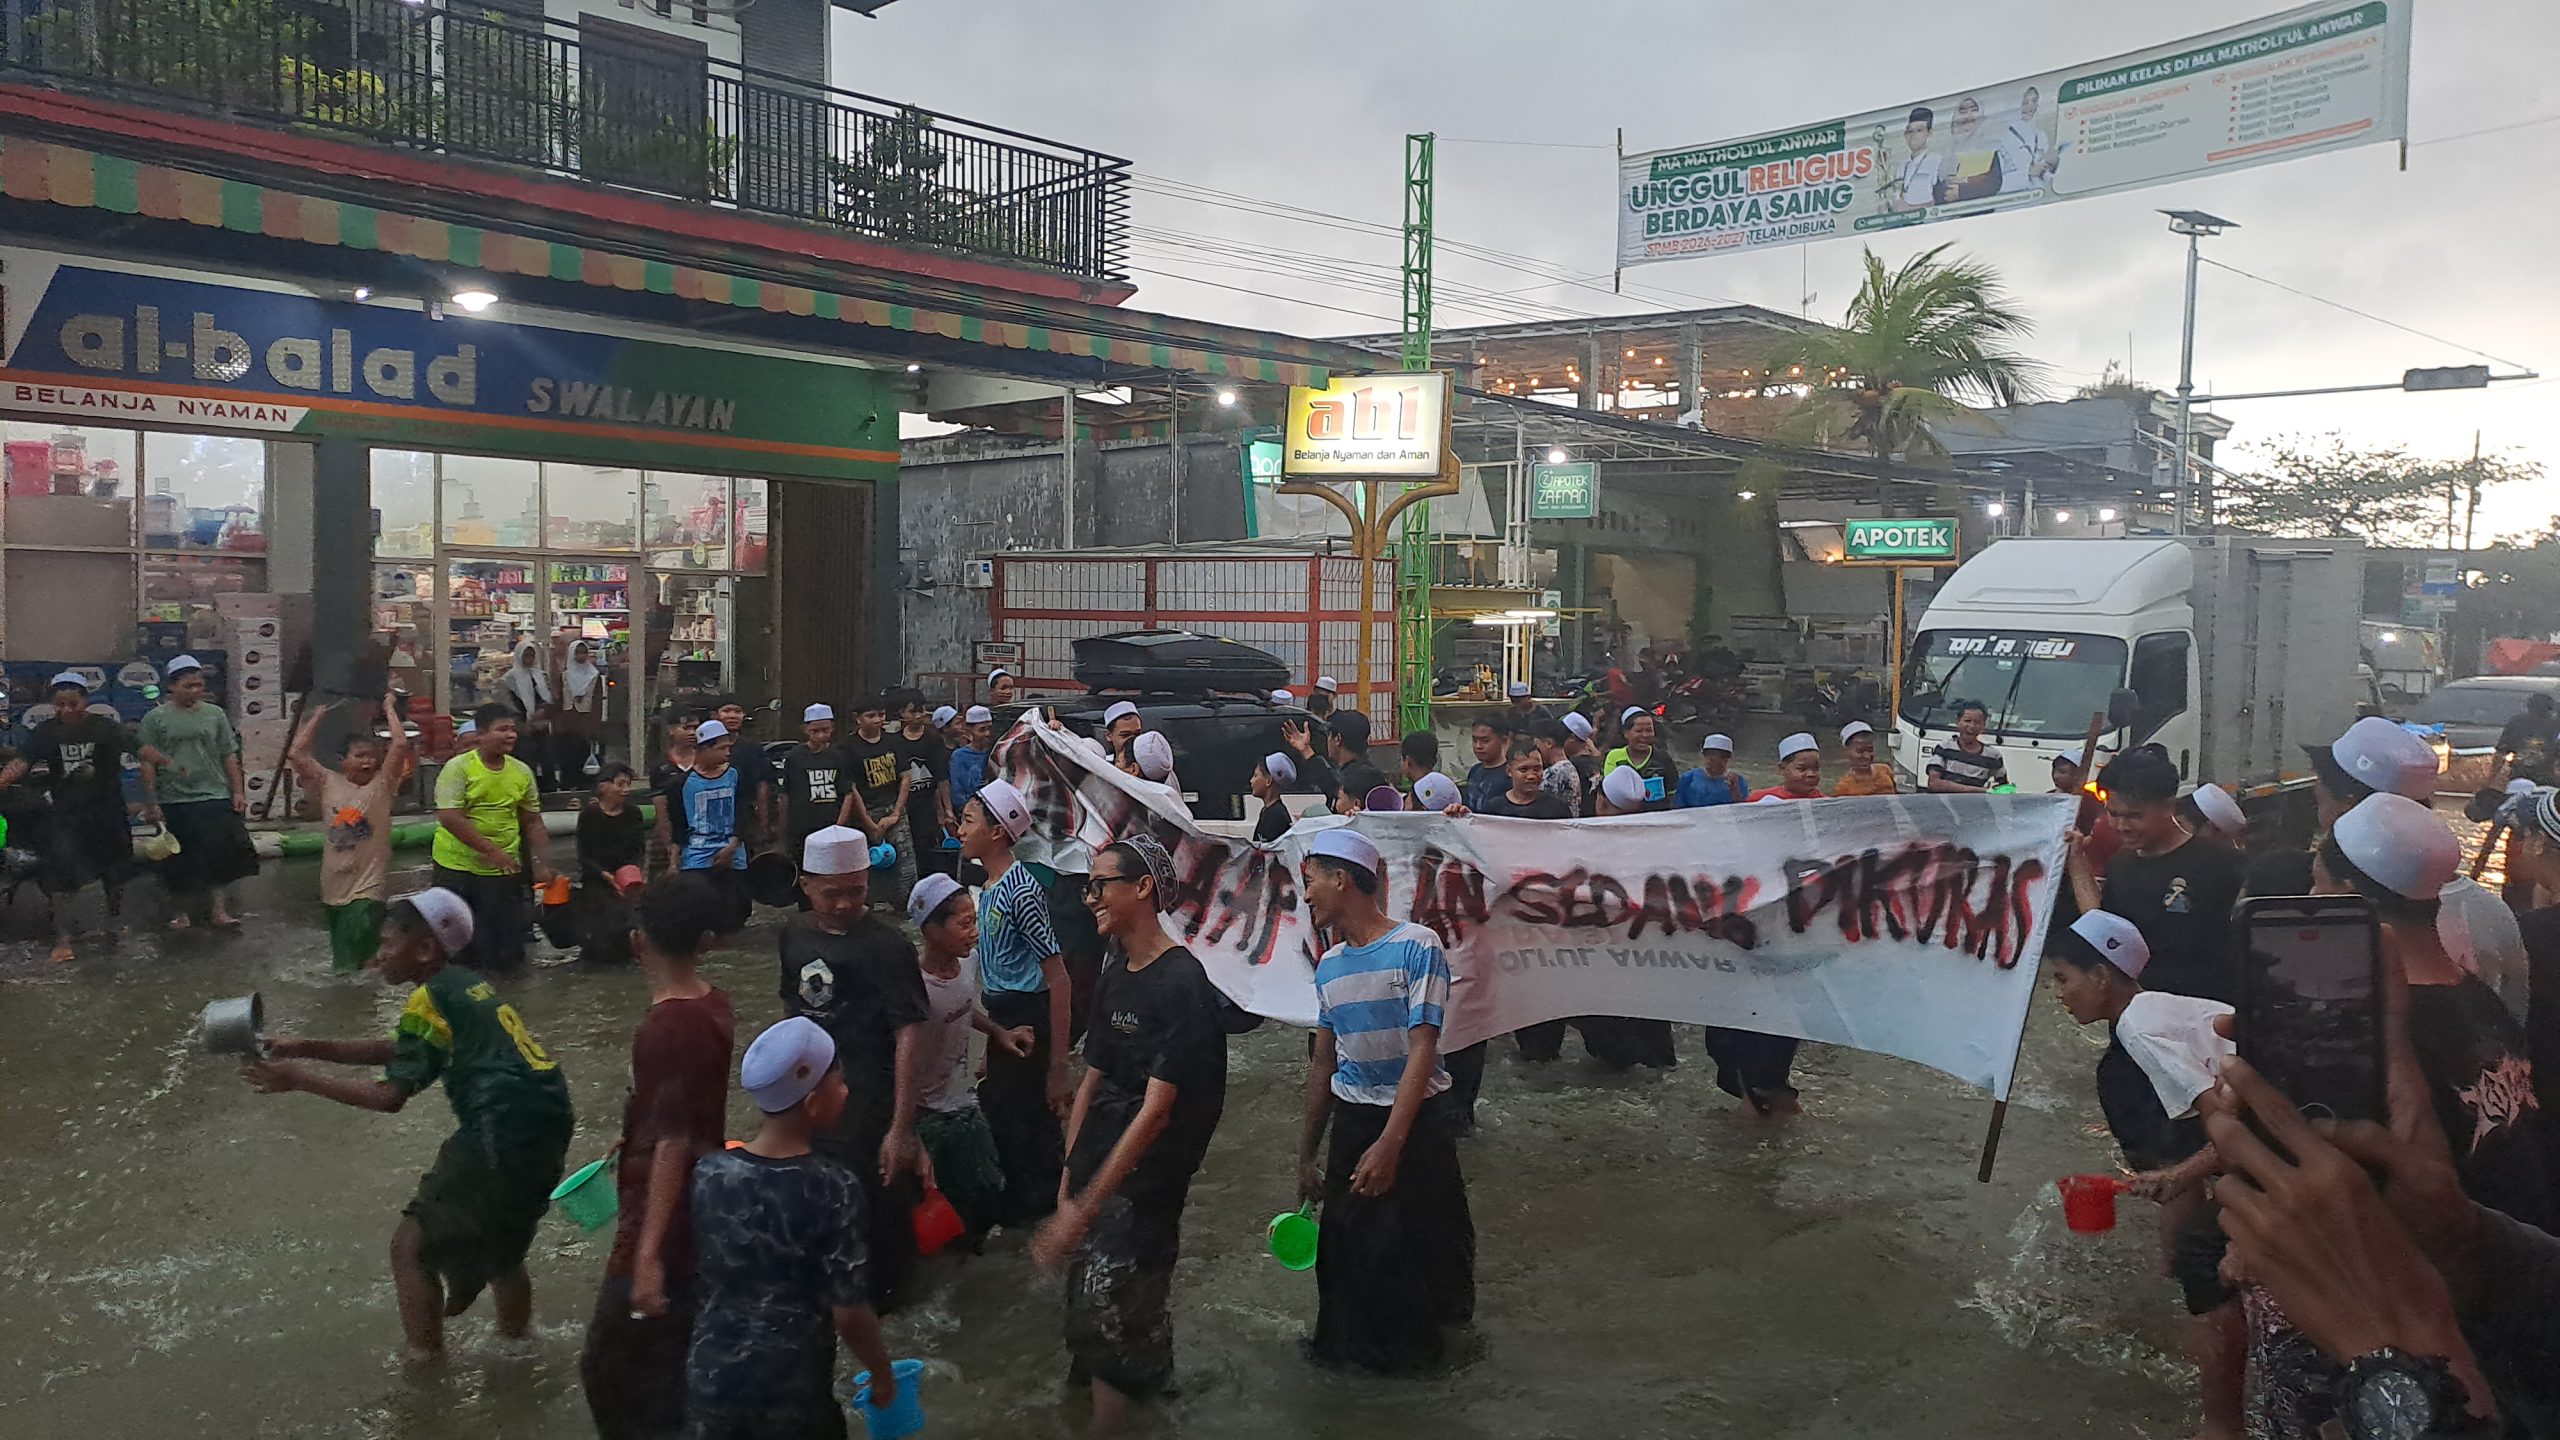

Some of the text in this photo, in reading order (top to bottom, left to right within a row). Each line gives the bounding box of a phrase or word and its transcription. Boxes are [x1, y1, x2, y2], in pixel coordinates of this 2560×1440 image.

[2076, 73, 2128, 95] PILIHAN
[2129, 61, 2172, 83] KELAS
[2173, 58, 2190, 74] DI
[2307, 11, 2364, 38] ANWAR
[1657, 157, 1681, 173] MA
[1778, 130, 1838, 152] ANWAR
[1631, 148, 1873, 208] UNGGUL RELIGIUS
[1645, 198, 1763, 236] BERDAYA
[1768, 184, 1854, 219] SAING
[1749, 223, 1786, 242] TELAH
[1788, 217, 1837, 237] DIBUKA
[14, 384, 290, 425] BELANJA NYAMAN
[526, 376, 737, 432] SWALAYAN
[1294, 449, 1430, 463] Belanja Nyaman dan Aman
[1553, 475, 1588, 487] APOTEK
[1850, 526, 1950, 548] APOTEK
